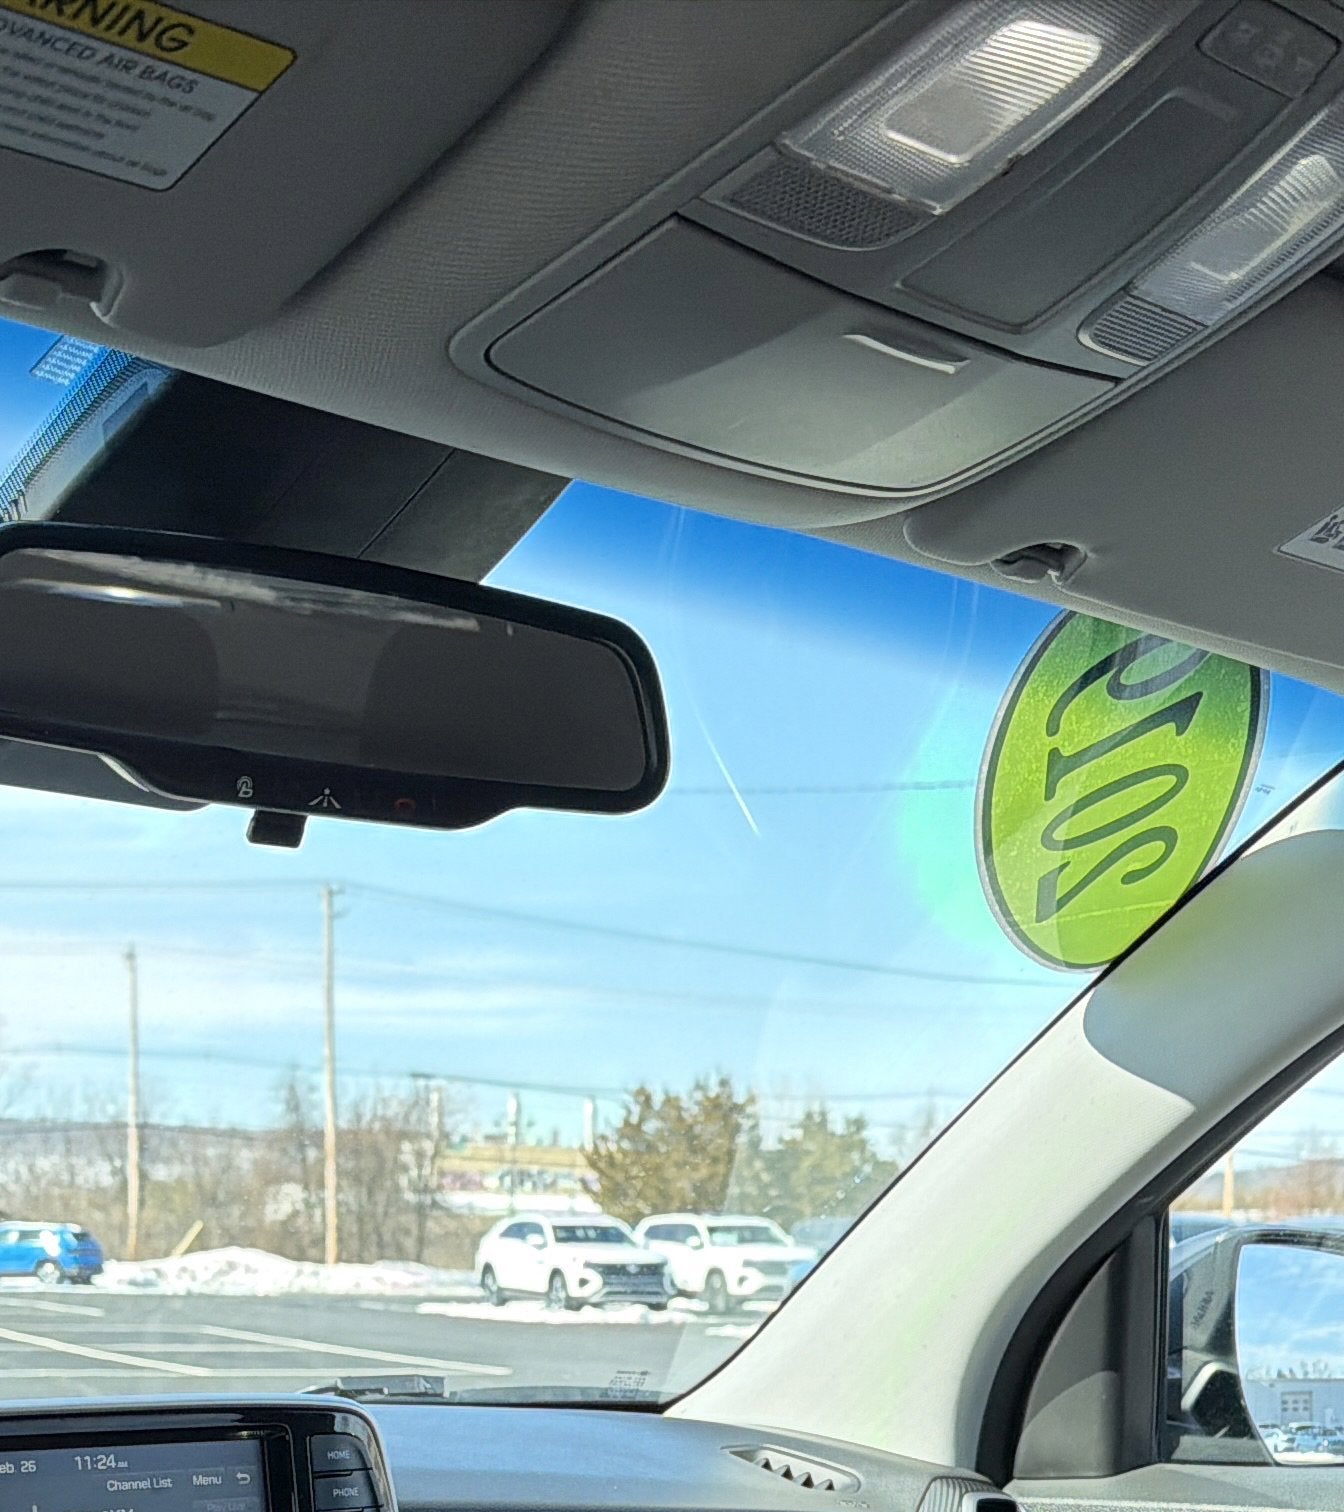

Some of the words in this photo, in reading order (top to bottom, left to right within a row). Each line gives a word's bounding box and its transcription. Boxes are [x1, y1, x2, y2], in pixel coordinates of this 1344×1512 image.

[98, 52, 137, 74] AIR
[138, 65, 199, 95] BAGS
[327, 1450, 351, 1460] HOME
[20, 1461, 37, 1474] 26
[75, 1453, 117, 1471] 11:24
[107, 1478, 152, 1492] Channel
[153, 1477, 173, 1489] List
[192, 1474, 222, 1487] Menu
[332, 1487, 360, 1498] PHONE
